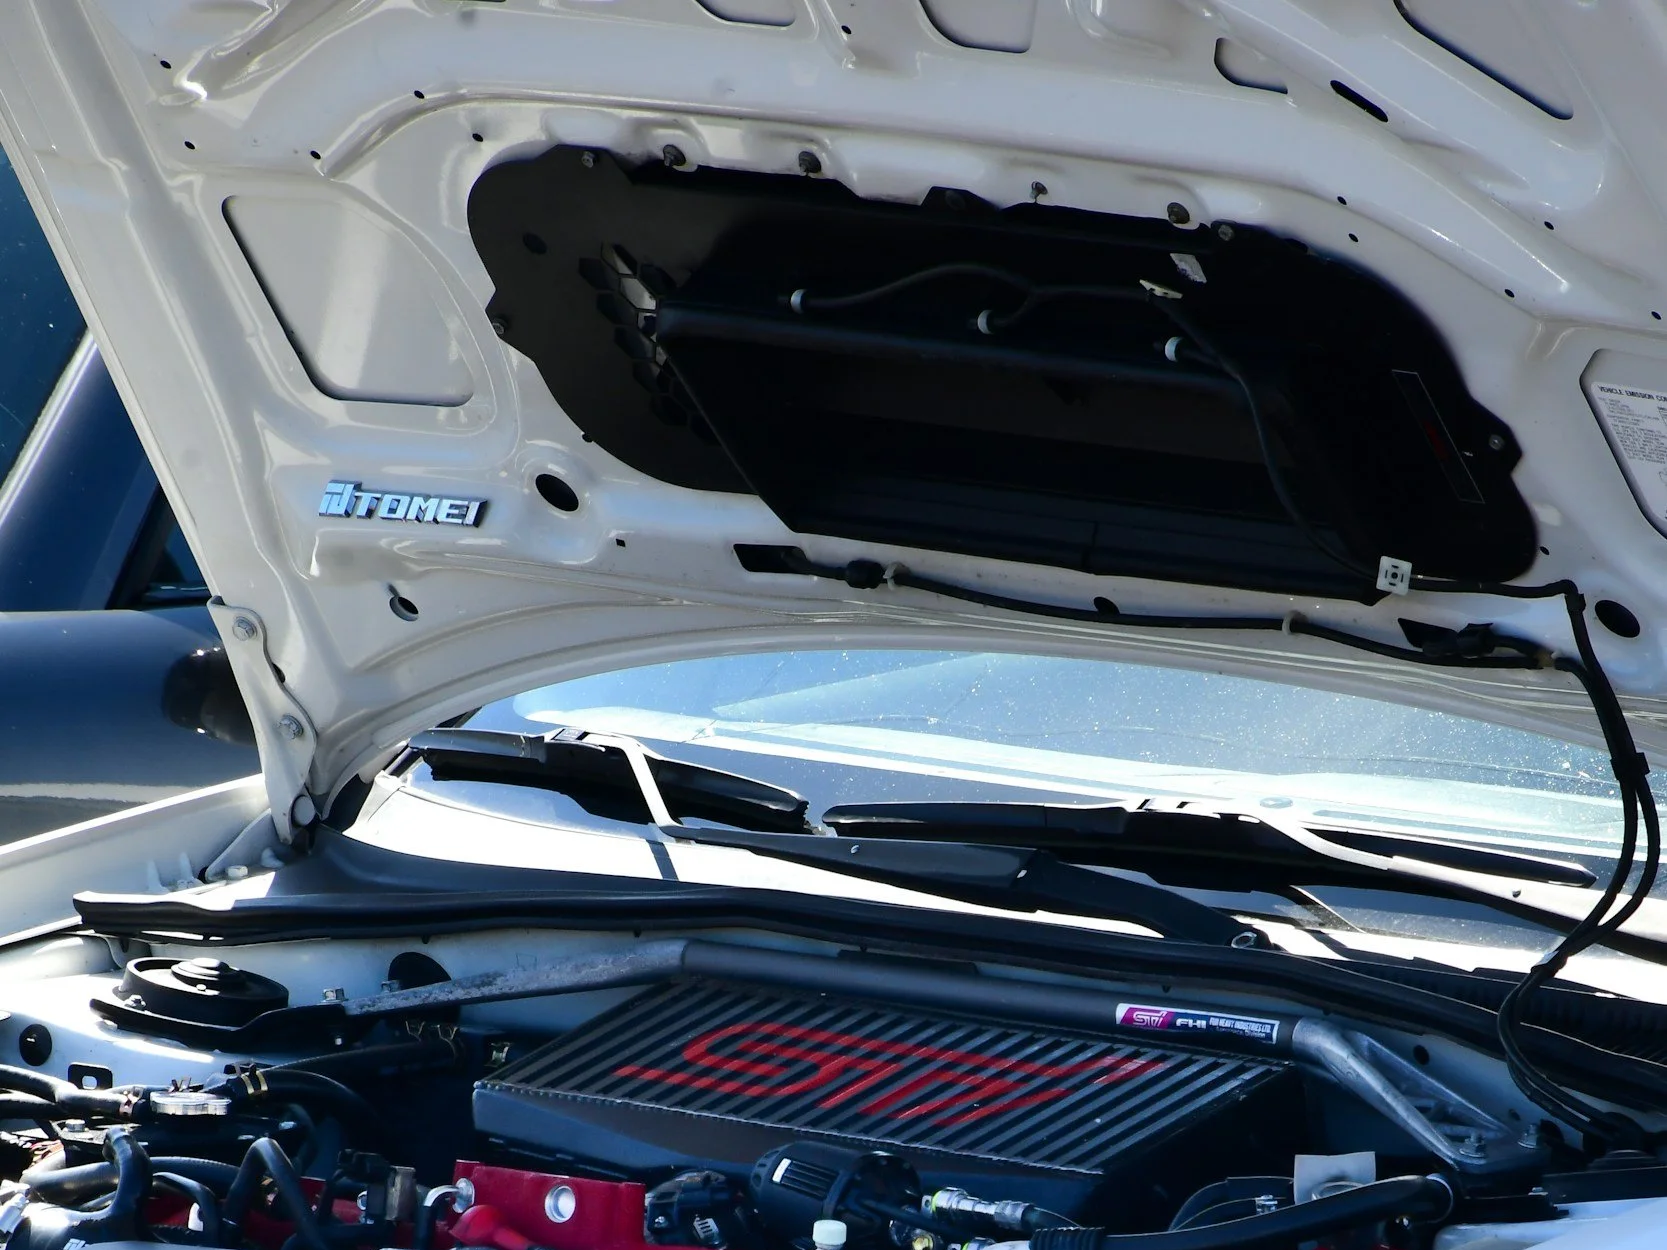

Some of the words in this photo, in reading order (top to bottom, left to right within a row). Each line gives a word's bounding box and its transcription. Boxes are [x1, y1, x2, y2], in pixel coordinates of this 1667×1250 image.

[1598, 385, 1624, 395] VEHICLE
[1625, 389, 1655, 400] EMISSION
[353, 491, 488, 527] TOMEI
